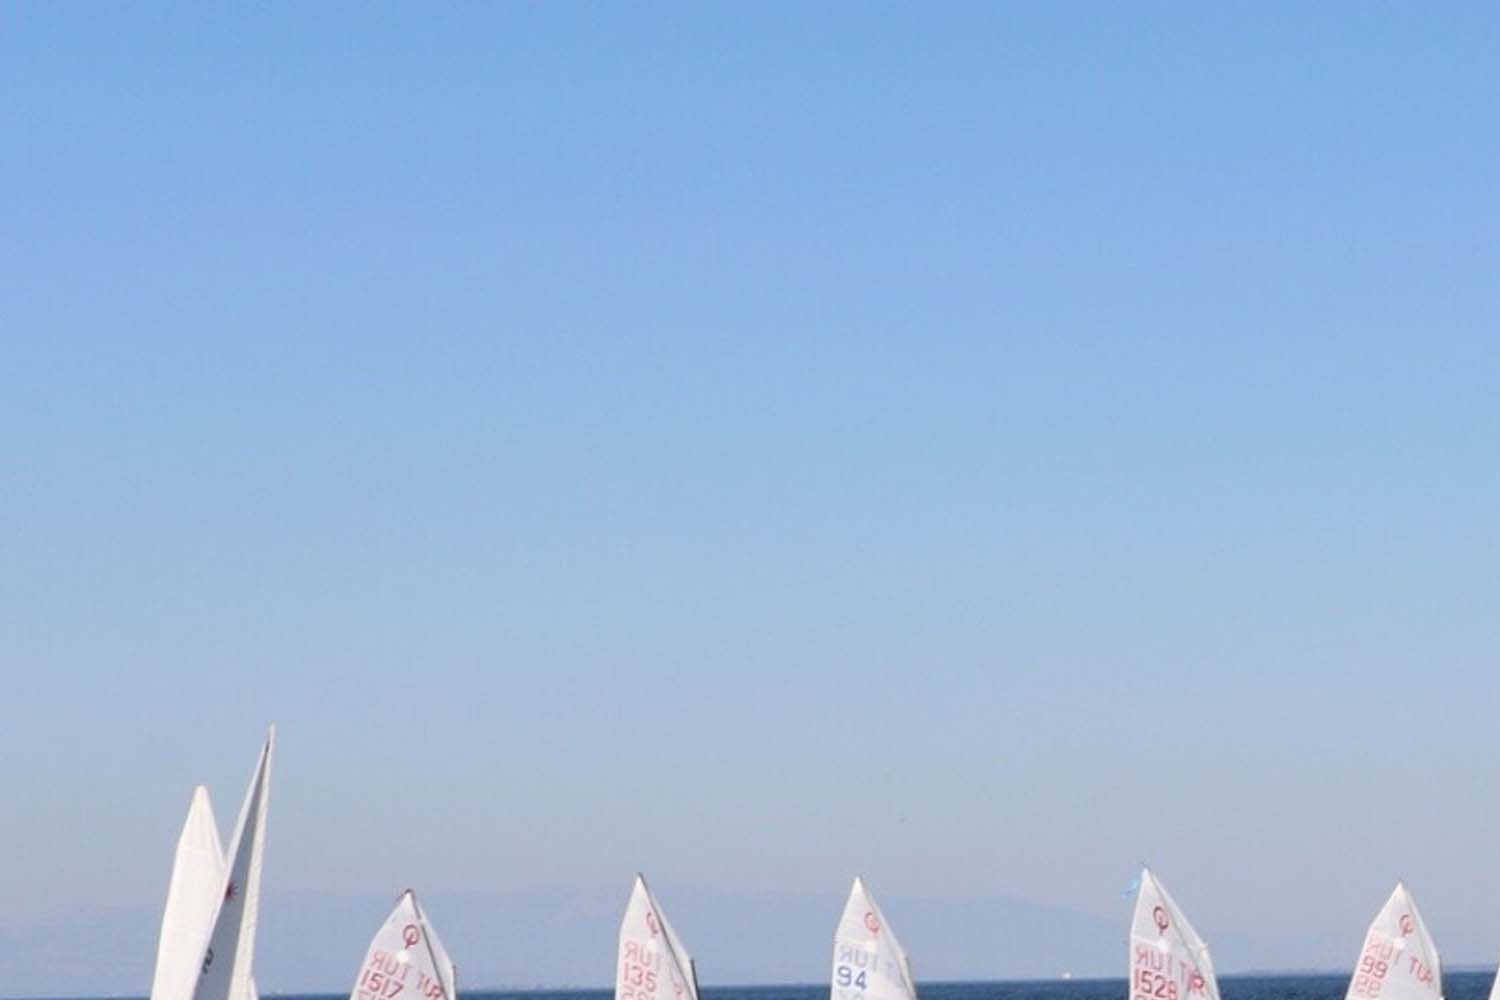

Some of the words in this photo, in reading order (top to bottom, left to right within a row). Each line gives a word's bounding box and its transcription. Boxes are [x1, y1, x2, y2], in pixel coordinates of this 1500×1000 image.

[624, 962, 657, 993] 135
[838, 965, 867, 991] 94
[1360, 956, 1388, 979] 99
[360, 969, 405, 999] 1517
